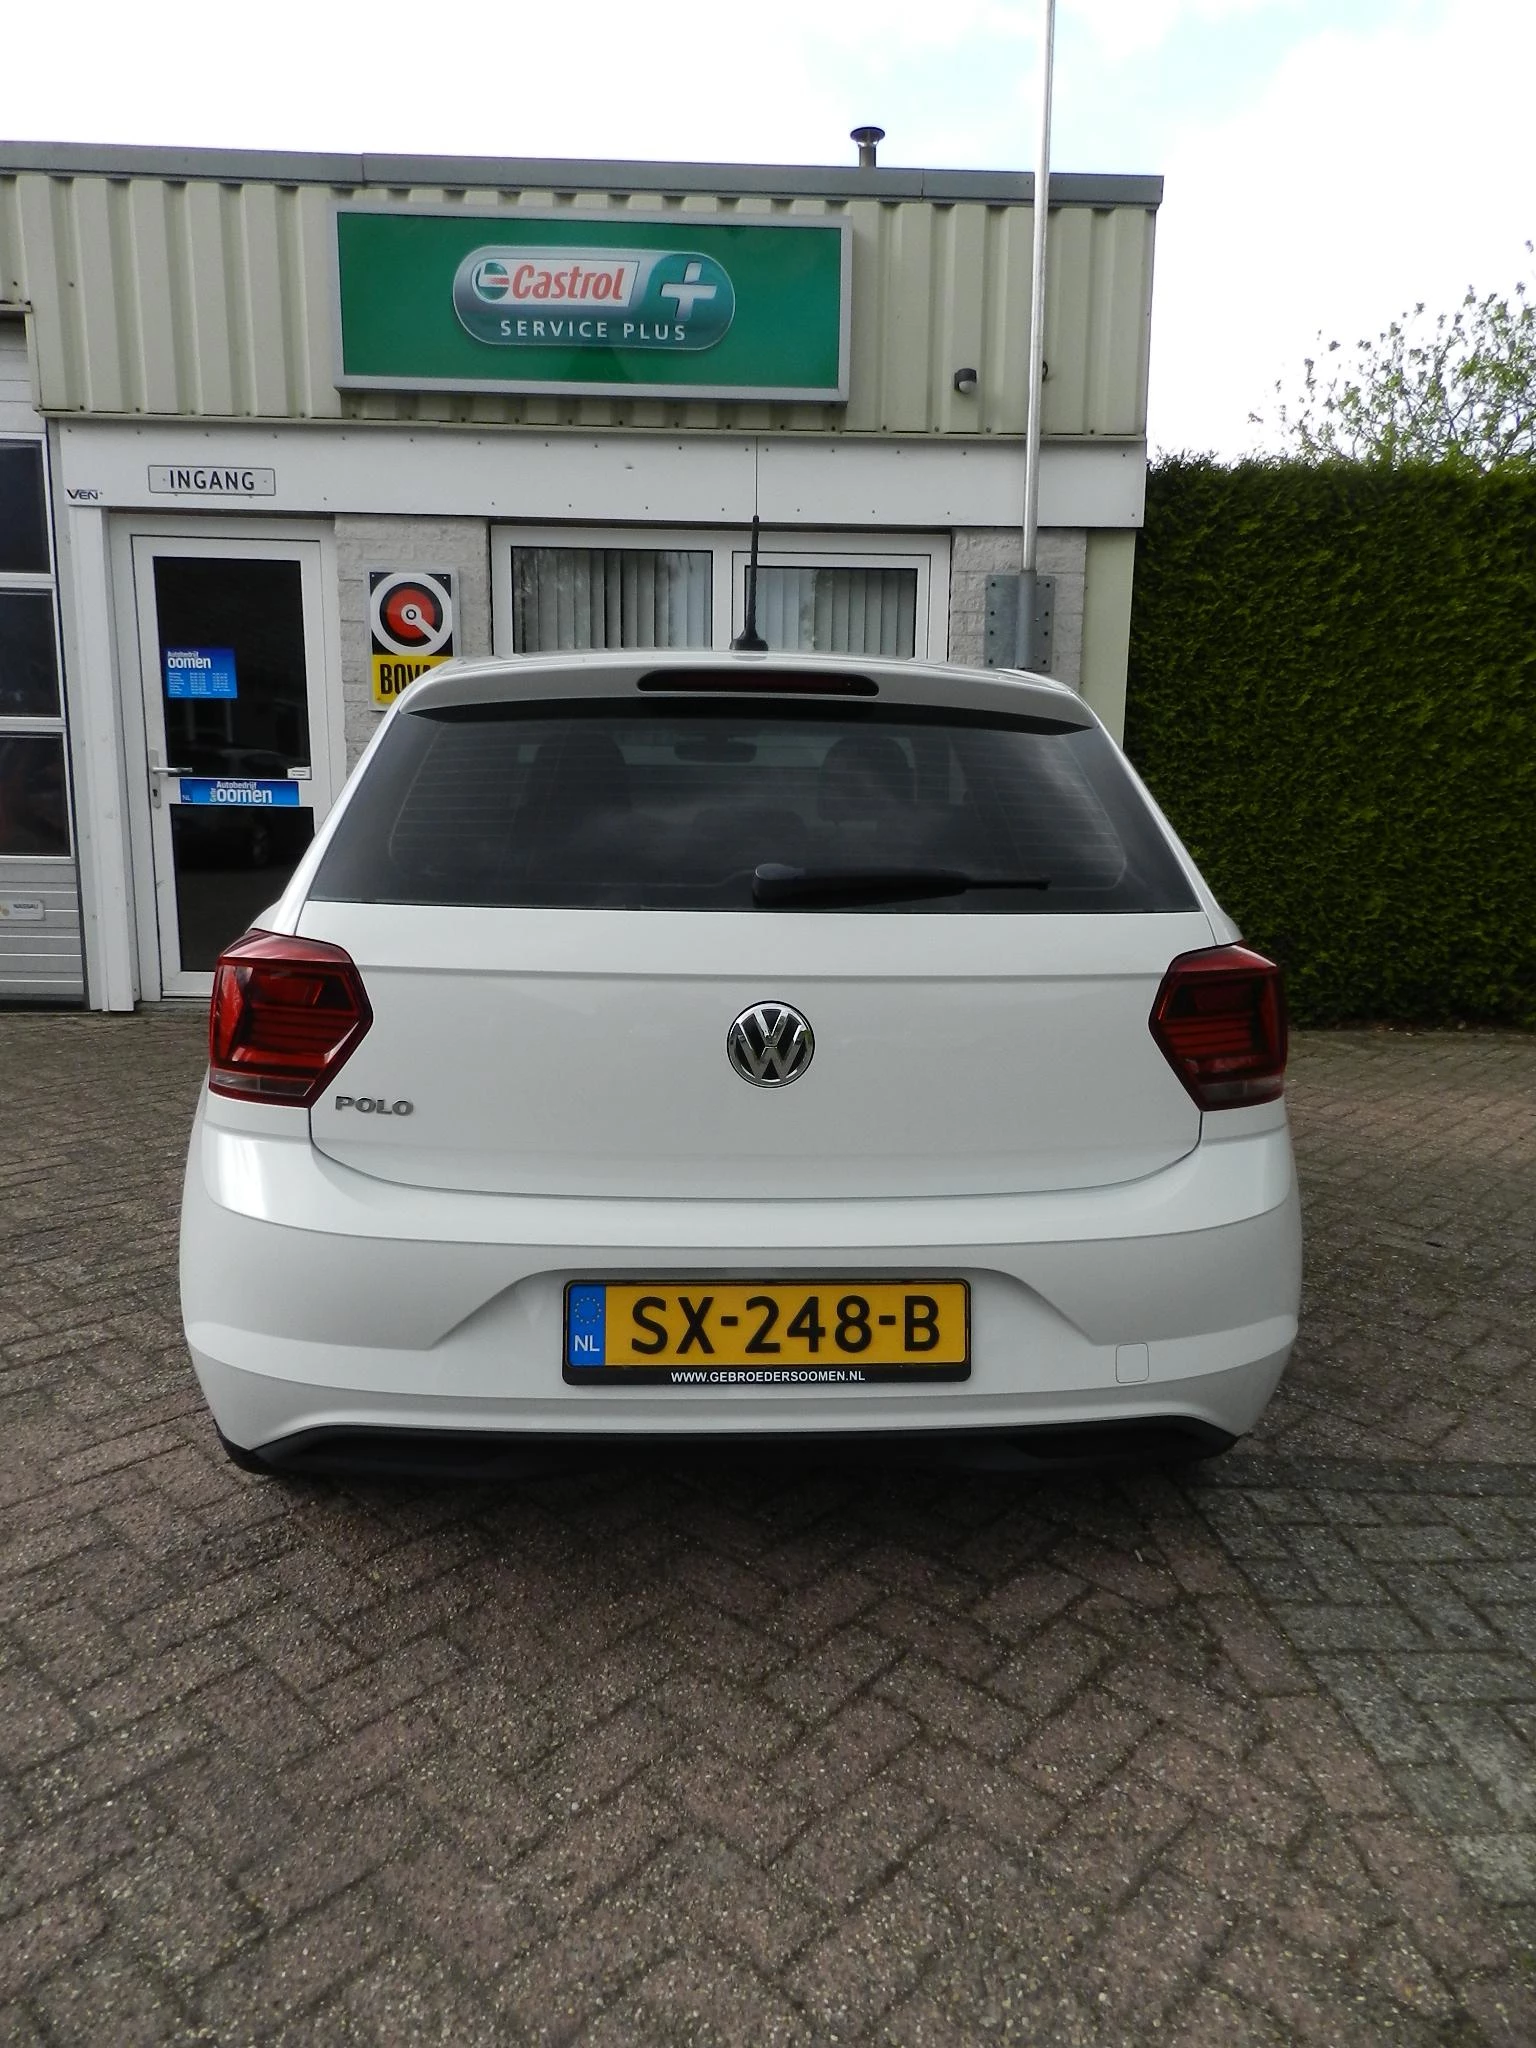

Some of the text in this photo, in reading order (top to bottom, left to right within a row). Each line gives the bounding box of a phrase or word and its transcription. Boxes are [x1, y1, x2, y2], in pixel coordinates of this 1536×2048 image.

[512, 264, 624, 300] Castrol
[500, 319, 686, 341] SERVICE PLUS
[169, 469, 255, 490] INGANG
[167, 657, 211, 669] oomen
[380, 663, 431, 695] BOV
[216, 788, 272, 804] oomen
[335, 1095, 414, 1116] POLO
[573, 1295, 940, 1354] NL SX-248-B
[670, 1370, 865, 1383] WWW.GEBROEDERSOOMEN.NL
